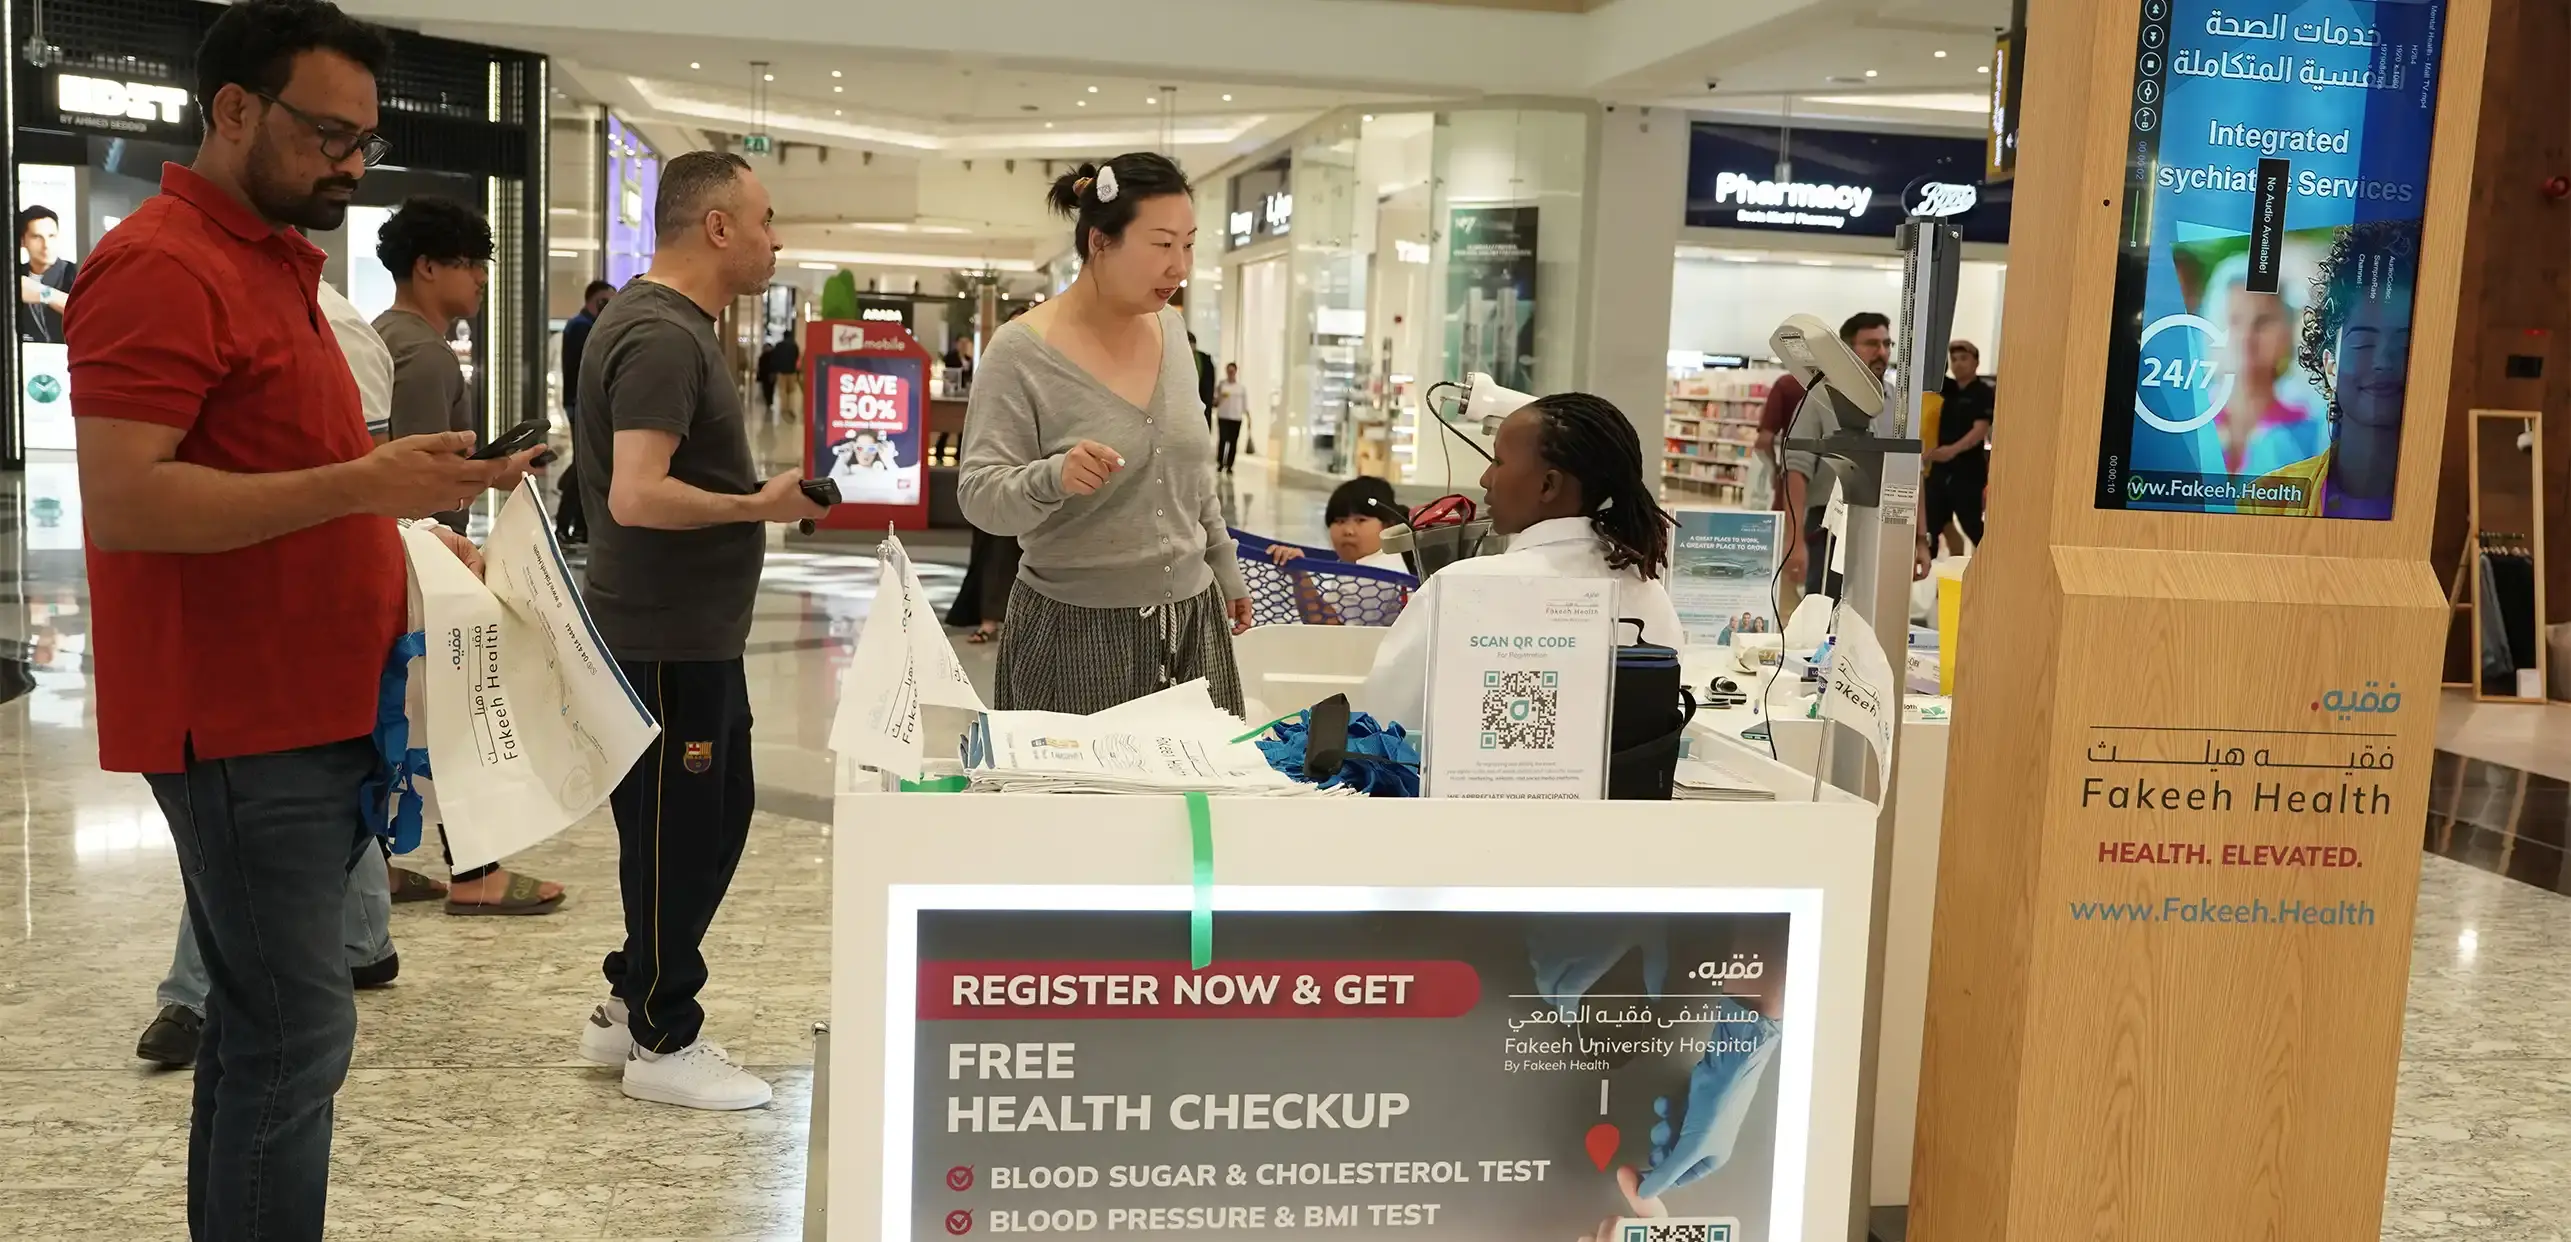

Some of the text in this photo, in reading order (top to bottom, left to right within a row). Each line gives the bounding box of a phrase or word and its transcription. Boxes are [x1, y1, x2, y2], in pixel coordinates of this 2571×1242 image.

[2204, 9, 2382, 47] خدمات الصحة
[2172, 48, 2293, 84] المتكاملة
[2209, 119, 2350, 155] Integrated
[1716, 172, 1873, 218] Pharmacy
[2297, 171, 2413, 202] Services
[2259, 177, 2276, 274] No Audio Available!
[840, 373, 898, 396] SAVE
[2141, 357, 2219, 390] 24/7
[839, 394, 897, 421] 50%
[1469, 635, 1576, 650] SCAN QR CODE
[485, 623, 519, 761] Fakeeh Health
[2081, 777, 2392, 815] Fakeeh Health
[2098, 842, 2364, 869] HEALTH. ELEVATED.
[2070, 897, 2376, 926] www.Fakeeh.Health
[952, 974, 1415, 1006] REGISTER NOW & GET
[1507, 1003, 1760, 1034] مستشفى فقيه الجامعي
[948, 1041, 1076, 1081] FREE
[1504, 1036, 1758, 1059] Fakeeh University Hospital
[1504, 1059, 1610, 1074] By Fakeeh Health
[947, 1092, 1411, 1134] HEALTH CHECKUP
[990, 1159, 1551, 1190] BLOOD SUGAR & CHOLESTEROL TEST
[988, 1203, 1442, 1235] BLOOD PRESSURE & BMI TEST
